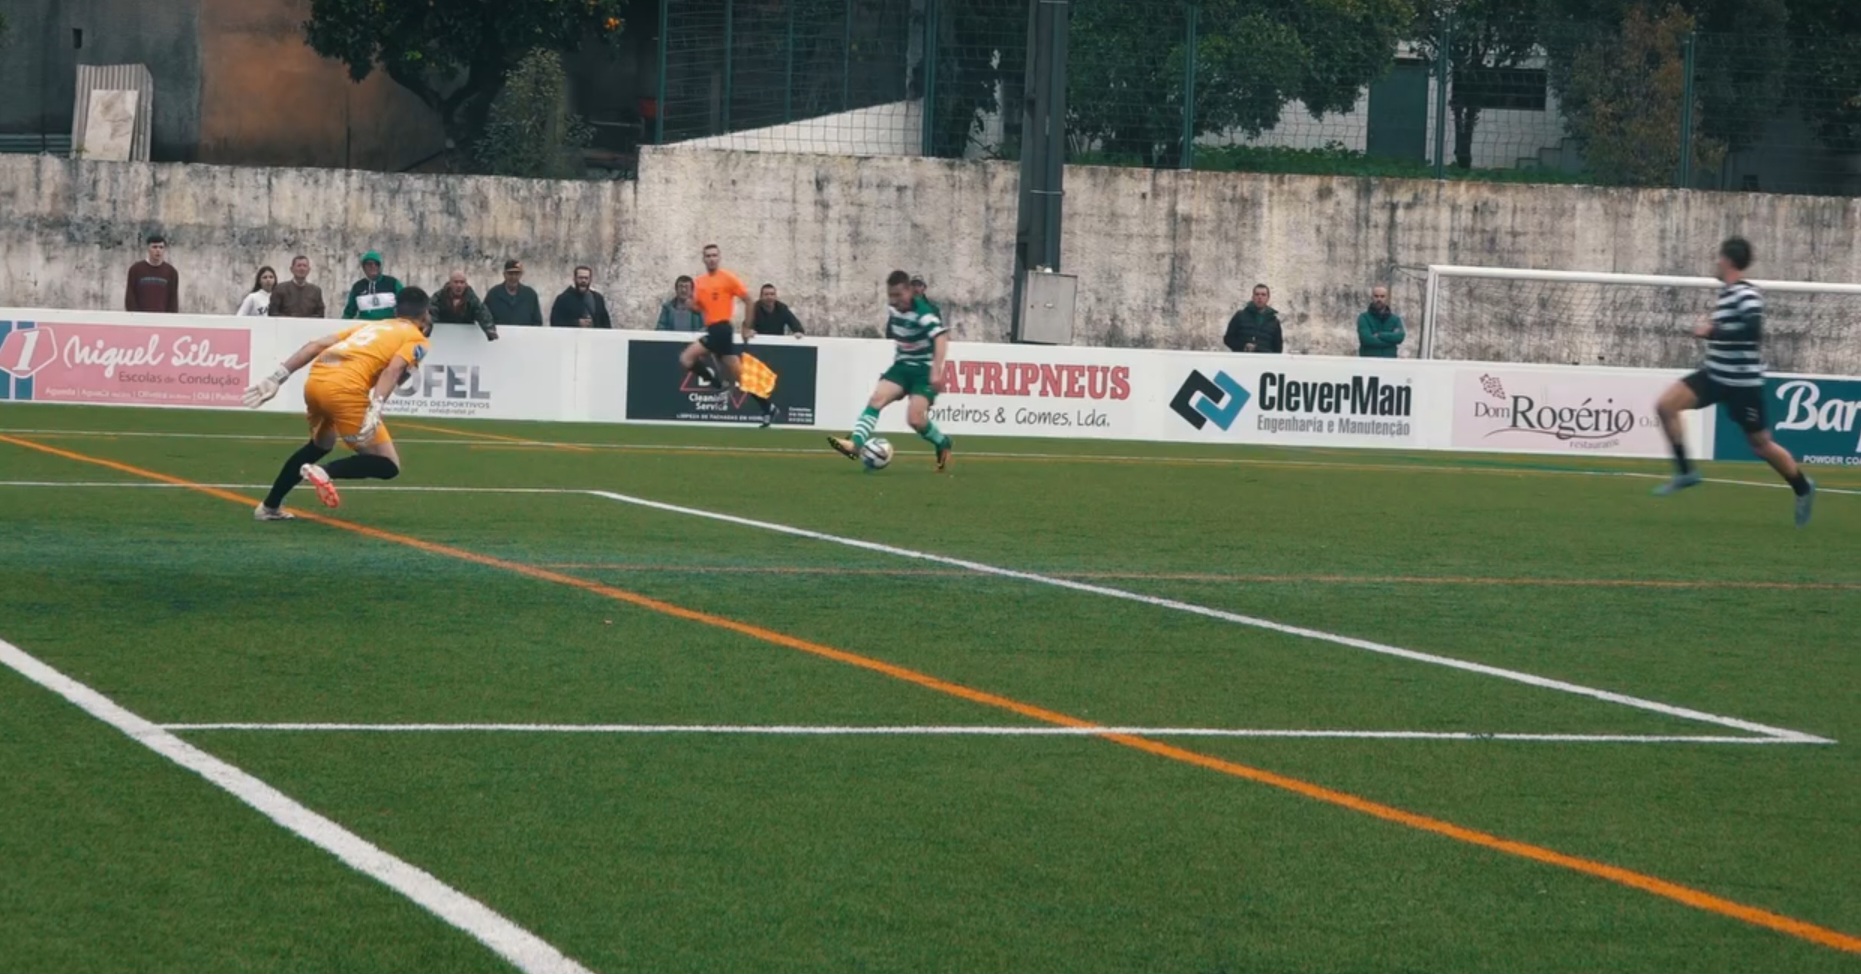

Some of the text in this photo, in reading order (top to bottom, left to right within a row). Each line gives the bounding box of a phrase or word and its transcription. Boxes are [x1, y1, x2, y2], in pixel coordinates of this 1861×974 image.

[63, 334, 249, 378] Miguel Silva
[119, 371, 241, 387] Escolas de Condução
[393, 364, 490, 399] OFEL
[939, 360, 1131, 400] ATRIPNEUS
[1258, 371, 1412, 416] CleverMan
[688, 392, 728, 411] Cleaning Service
[928, 404, 990, 422] onteiros
[994, 406, 1006, 424] &
[1076, 408, 1110, 427] Lda.
[1474, 402, 1510, 419] Dom
[1510, 395, 1635, 439] Rogério
[1775, 380, 1861, 453] Bar
[1257, 414, 1410, 438] Engenharia e Manutenção
[1803, 455, 1843, 464] POWDER
